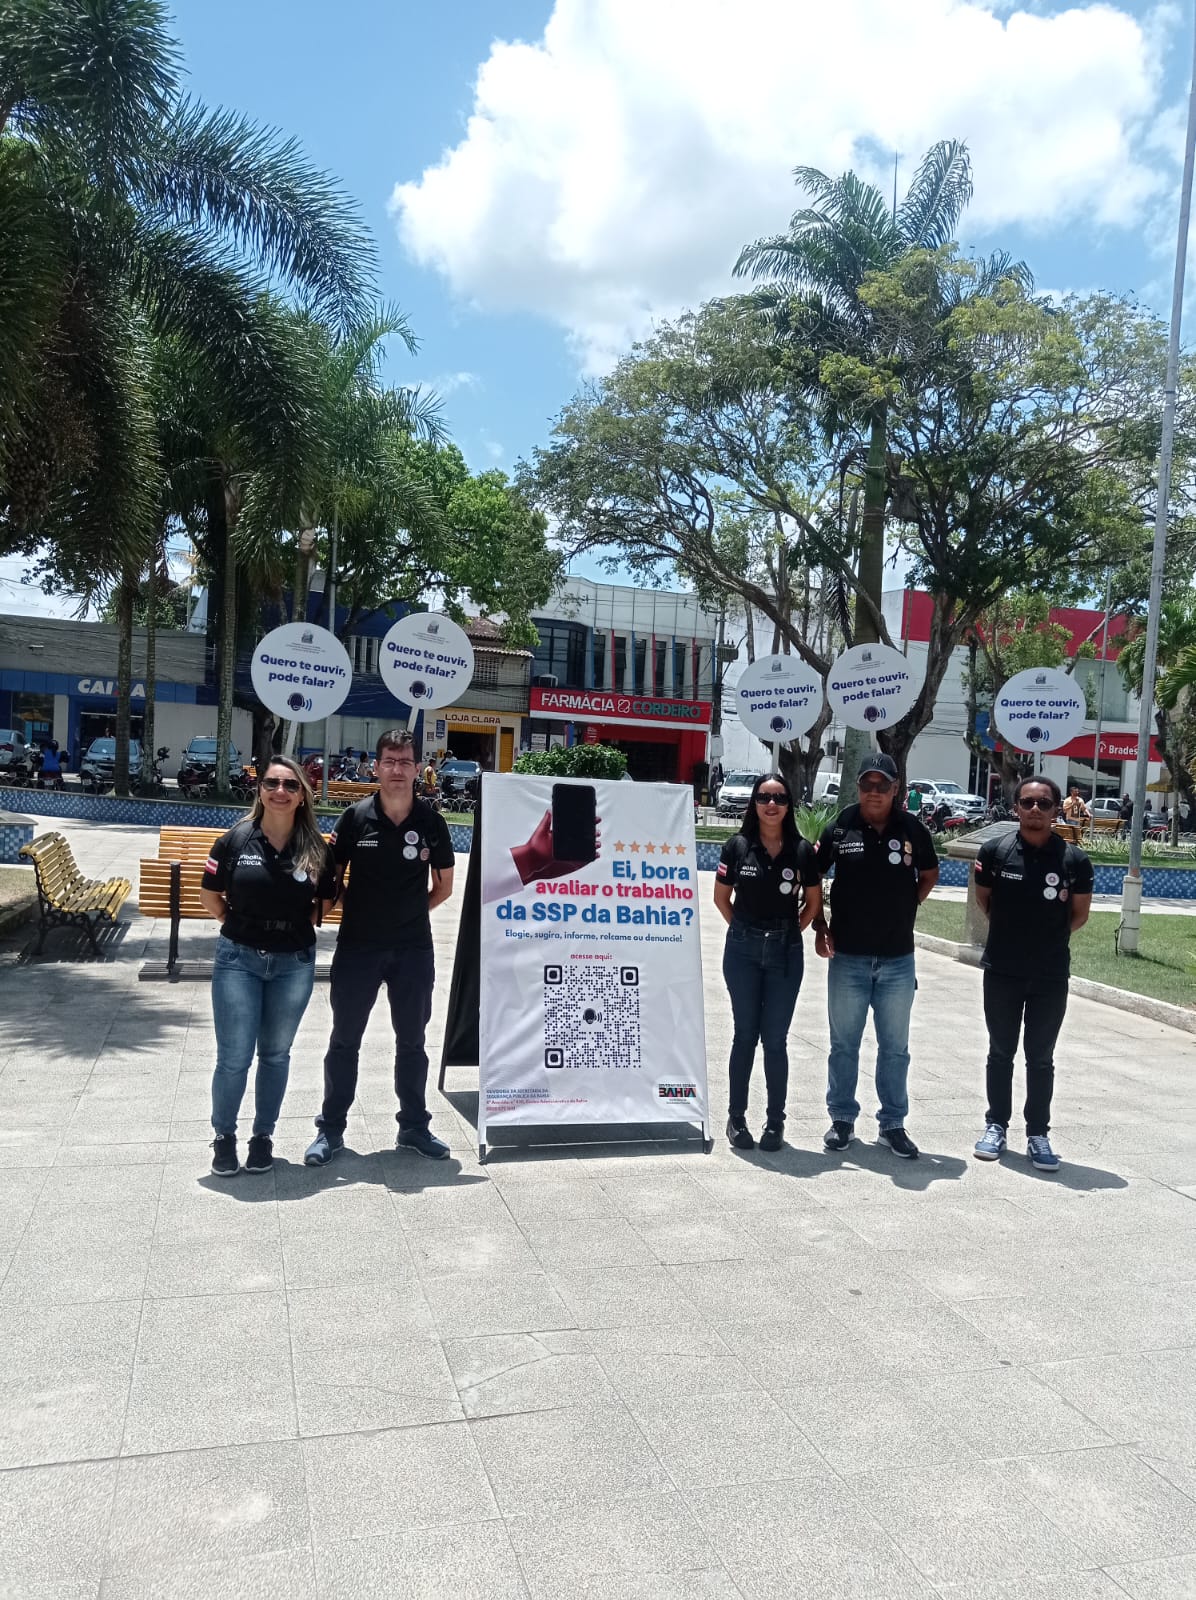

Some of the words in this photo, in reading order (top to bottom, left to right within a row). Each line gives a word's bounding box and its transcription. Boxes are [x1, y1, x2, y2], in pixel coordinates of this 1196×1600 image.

[387, 642, 422, 656] Quero
[424, 650, 435, 660] te
[436, 654, 468, 668] ouvir,
[260, 654, 298, 668] Quero
[300, 660, 312, 670] te
[313, 665, 346, 678] ouvir,
[393, 660, 423, 672] pode
[424, 664, 456, 678] falar?
[78, 679, 146, 698] CAIA
[268, 672, 300, 684] pode
[302, 676, 336, 688] falar?
[832, 680, 864, 690] Quero
[866, 677, 877, 686] te
[878, 672, 909, 684] ouvir,
[740, 688, 772, 698] Quero
[774, 687, 785, 696] te
[786, 684, 817, 694] ouvir,
[842, 692, 870, 704] pode
[871, 686, 902, 697] falar?
[541, 692, 615, 712] FARMÁCIA
[632, 701, 701, 718] CORDEIRO
[750, 700, 777, 712] pode
[778, 698, 808, 708] falar?
[1000, 698, 1034, 707] Quero
[1036, 699, 1046, 707] te
[1048, 698, 1080, 708] ouvir,
[446, 714, 470, 722] LOJA
[472, 716, 500, 724] CLARA
[1008, 711, 1037, 721] pode
[1038, 711, 1070, 720] falar?
[612, 860, 637, 881] Ei,
[641, 860, 690, 880] bora
[535, 879, 599, 896] avaliar
[602, 884, 614, 897] o
[616, 882, 693, 900] trabalho
[496, 900, 527, 921] da
[531, 902, 578, 922] SSP
[581, 903, 611, 924] da
[616, 906, 694, 926] Bahia?
[505, 929, 533, 939] Elogie,
[534, 931, 563, 940] sugira,
[564, 932, 598, 940] informe,
[645, 933, 683, 942] denuncie!
[594, 953, 613, 961] aqui:
[658, 1088, 696, 1098] BAHIA
